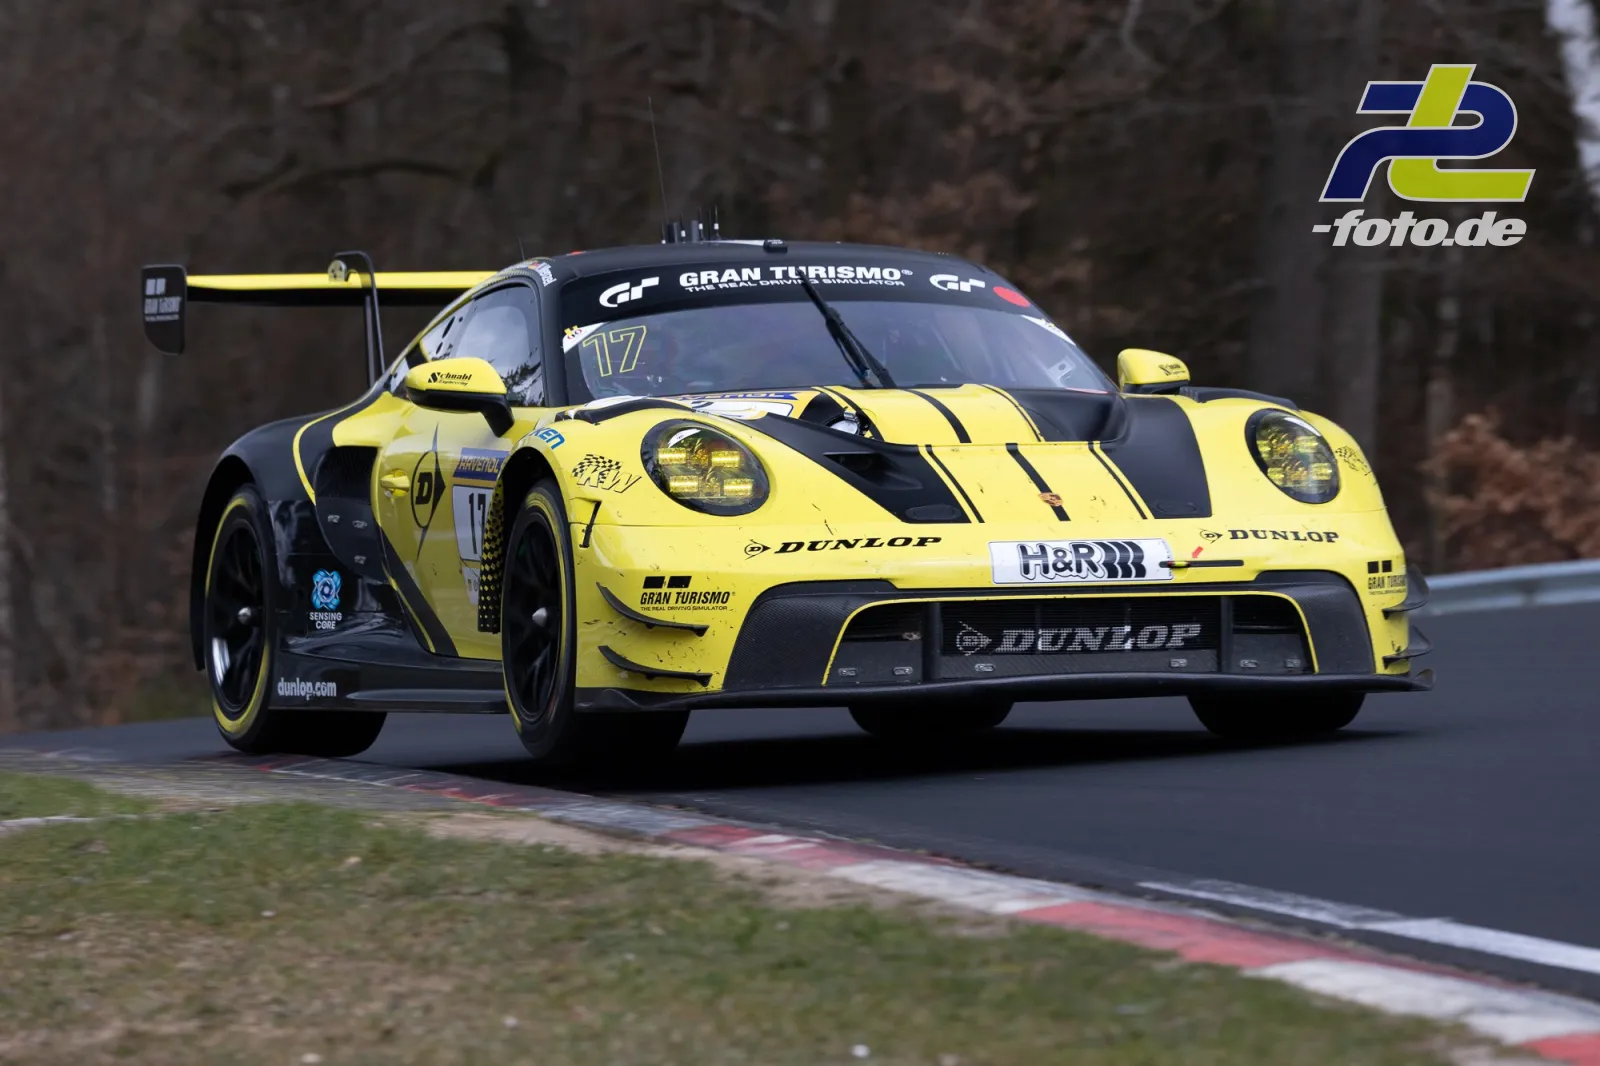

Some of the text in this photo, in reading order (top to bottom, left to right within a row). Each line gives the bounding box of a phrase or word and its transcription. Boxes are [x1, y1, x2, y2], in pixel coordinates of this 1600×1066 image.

[679, 267, 761, 287] GRAN
[684, 284, 716, 293] THE
[718, 281, 757, 289] REAL
[822, 278, 906, 287] SIMULATOR
[929, 273, 986, 293] GT
[599, 276, 660, 308] GT
[582, 325, 648, 378] 17
[459, 455, 500, 473] RAVENOL
[468, 491, 487, 555] 17
[774, 536, 942, 554] DUNLOP
[1227, 529, 1340, 543] DUNLOP
[1017, 542, 1105, 580] H&R
[640, 591, 672, 605] GRAN
[309, 611, 343, 621] SENSING
[315, 620, 336, 630] CORE
[993, 623, 1202, 653] DUNLOP
[277, 677, 338, 701] dunlop.com
